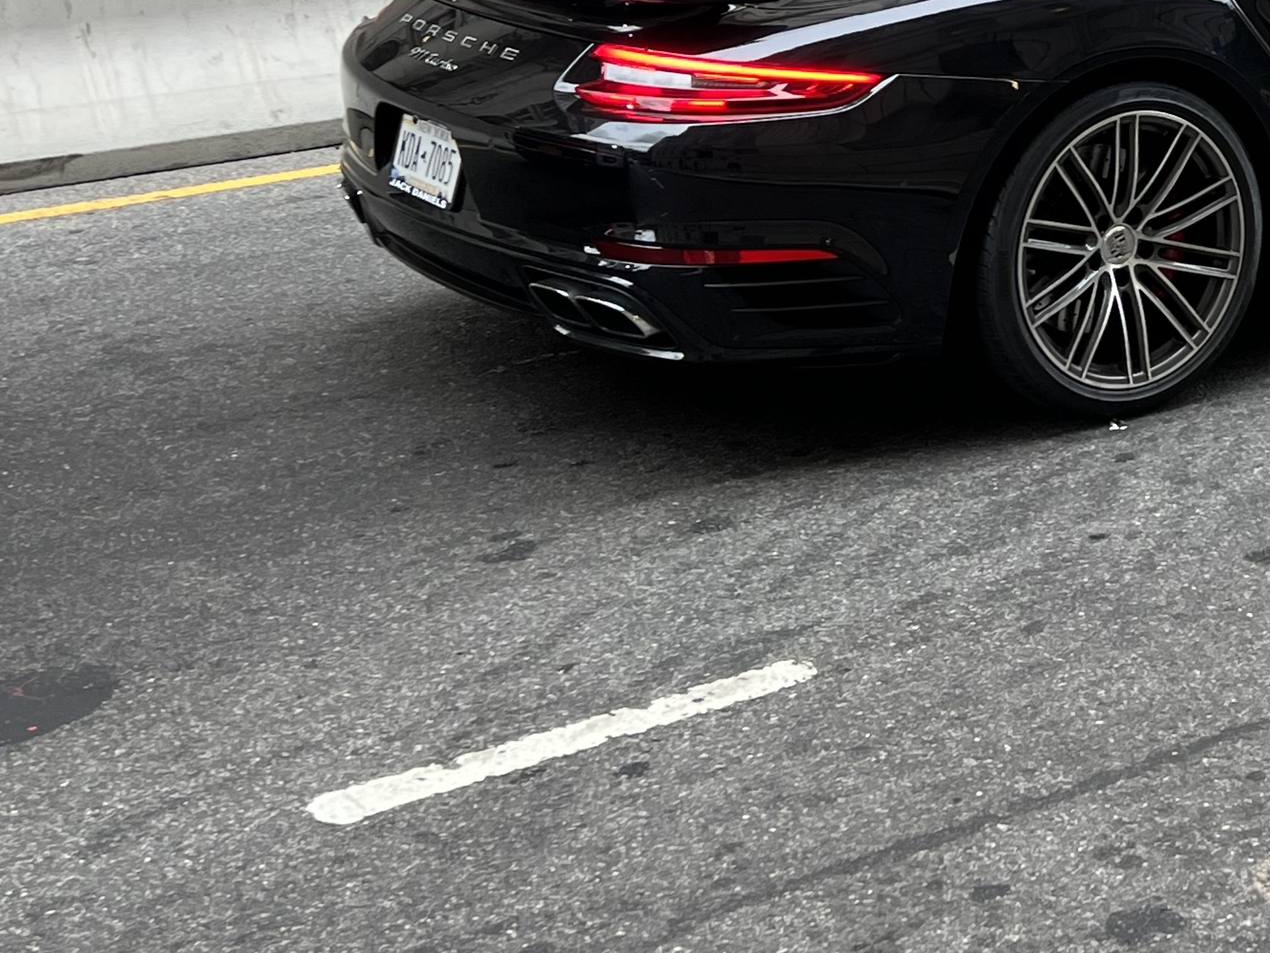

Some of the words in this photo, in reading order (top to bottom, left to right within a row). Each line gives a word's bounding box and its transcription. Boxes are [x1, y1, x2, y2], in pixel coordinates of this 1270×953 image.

[399, 13, 520, 61] PORSCHE
[409, 47, 429, 61] 911
[397, 130, 421, 173] KDA
[389, 178, 412, 194] JACK
[411, 186, 448, 210] DANIELS
